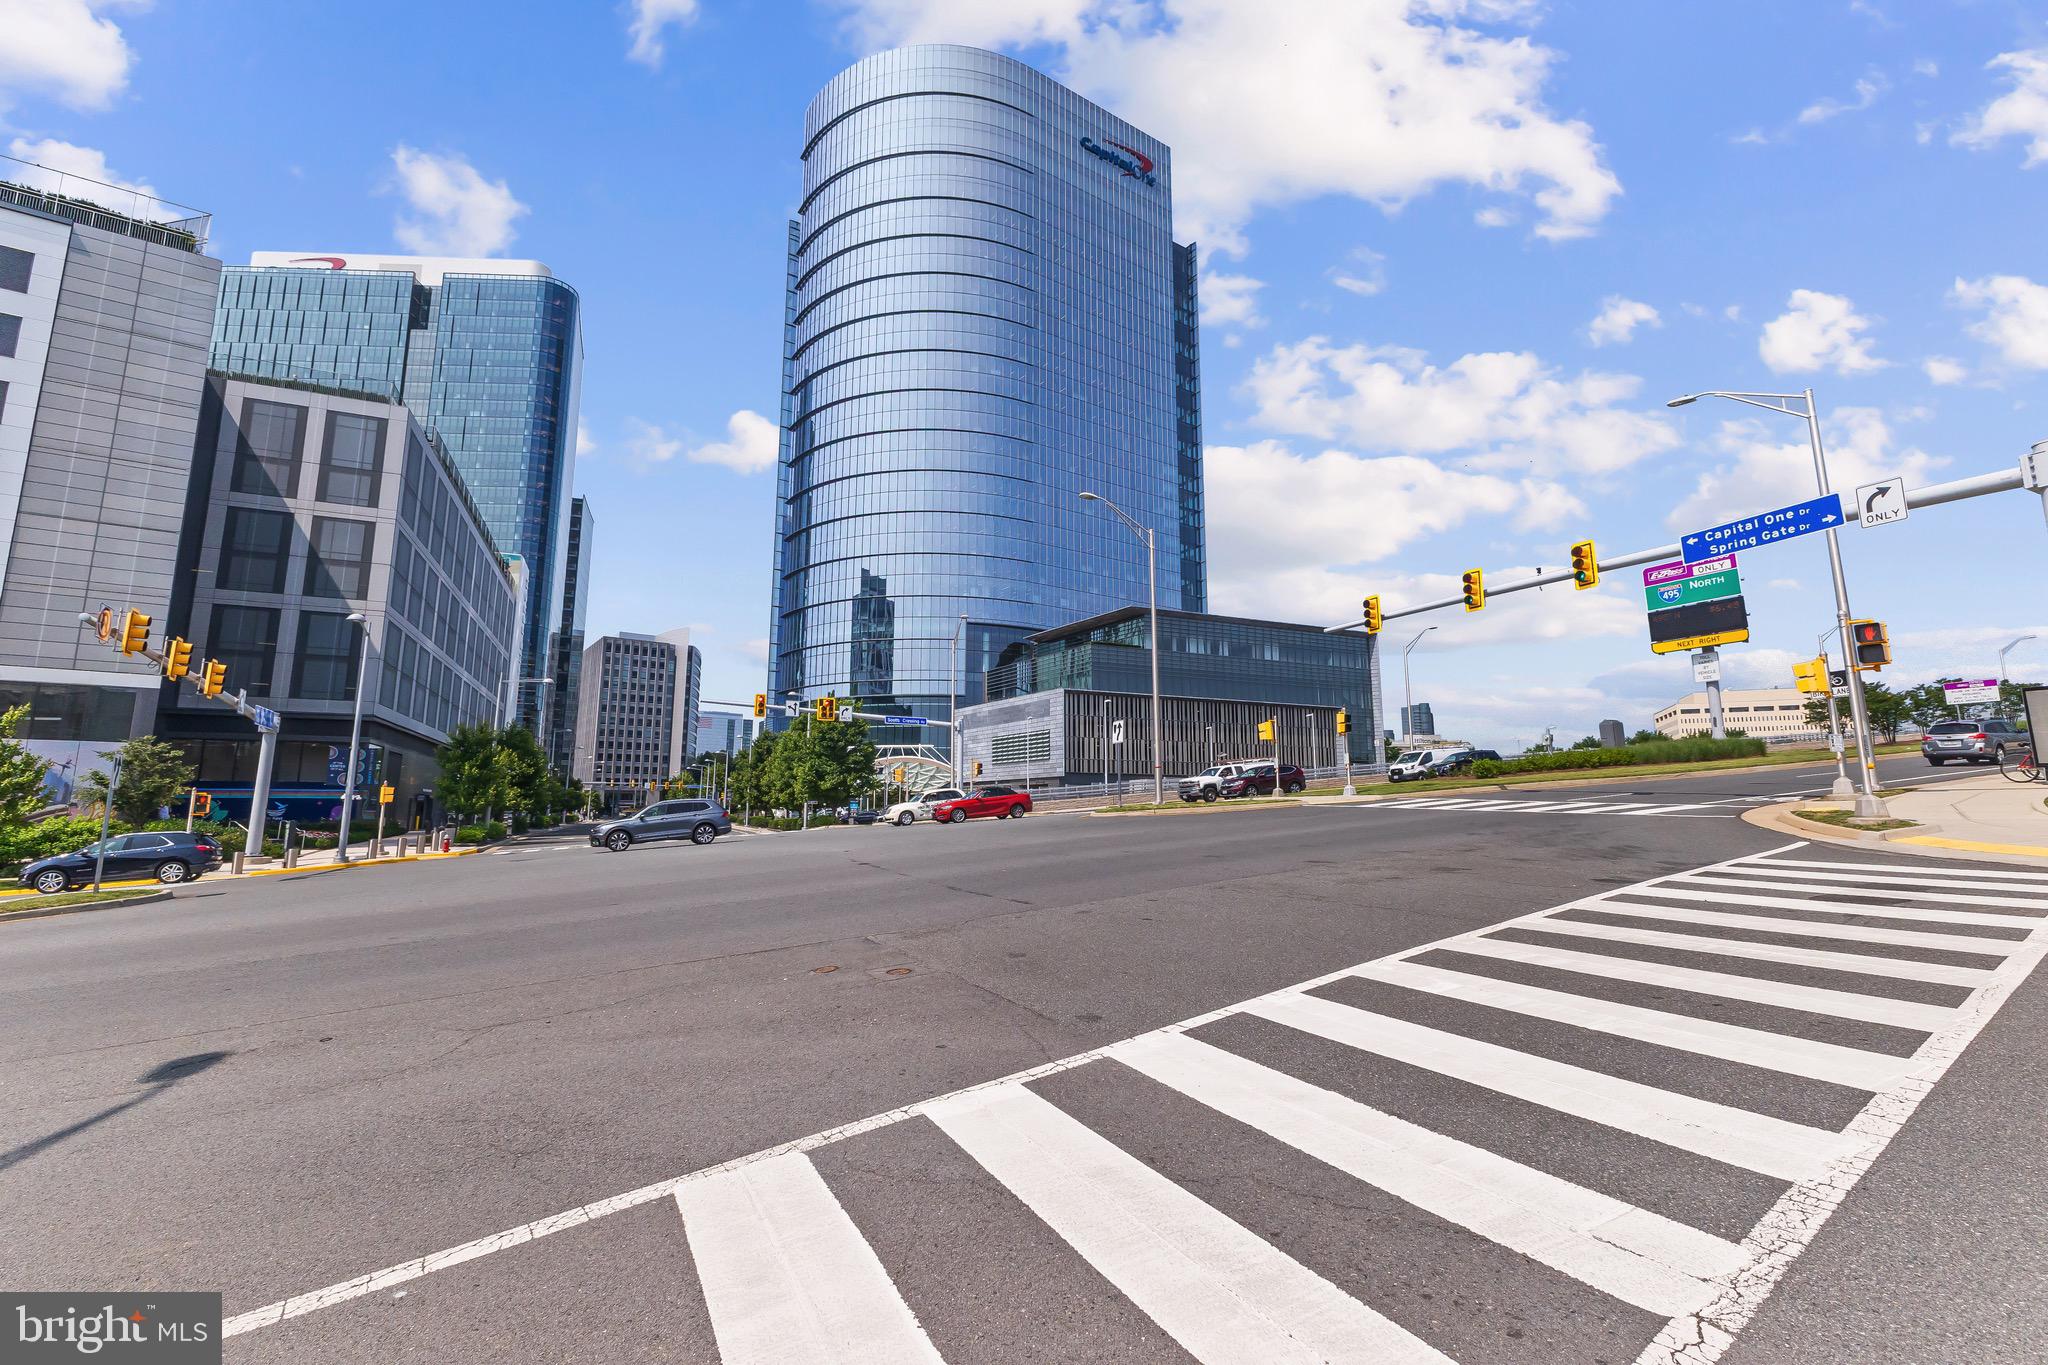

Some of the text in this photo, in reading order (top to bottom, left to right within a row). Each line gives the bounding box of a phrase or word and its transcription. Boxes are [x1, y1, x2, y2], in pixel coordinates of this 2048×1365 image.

[1866, 508, 1900, 524] ONLY
[1704, 507, 1811, 542] Capital One Dr
[1709, 522, 1811, 555] Spring Gate Dr
[1697, 561, 1725, 574] ONLY
[1689, 575, 1725, 589] NORTH
[1662, 589, 1680, 600] 495
[1677, 635, 1721, 648] NEXT RIGHT
